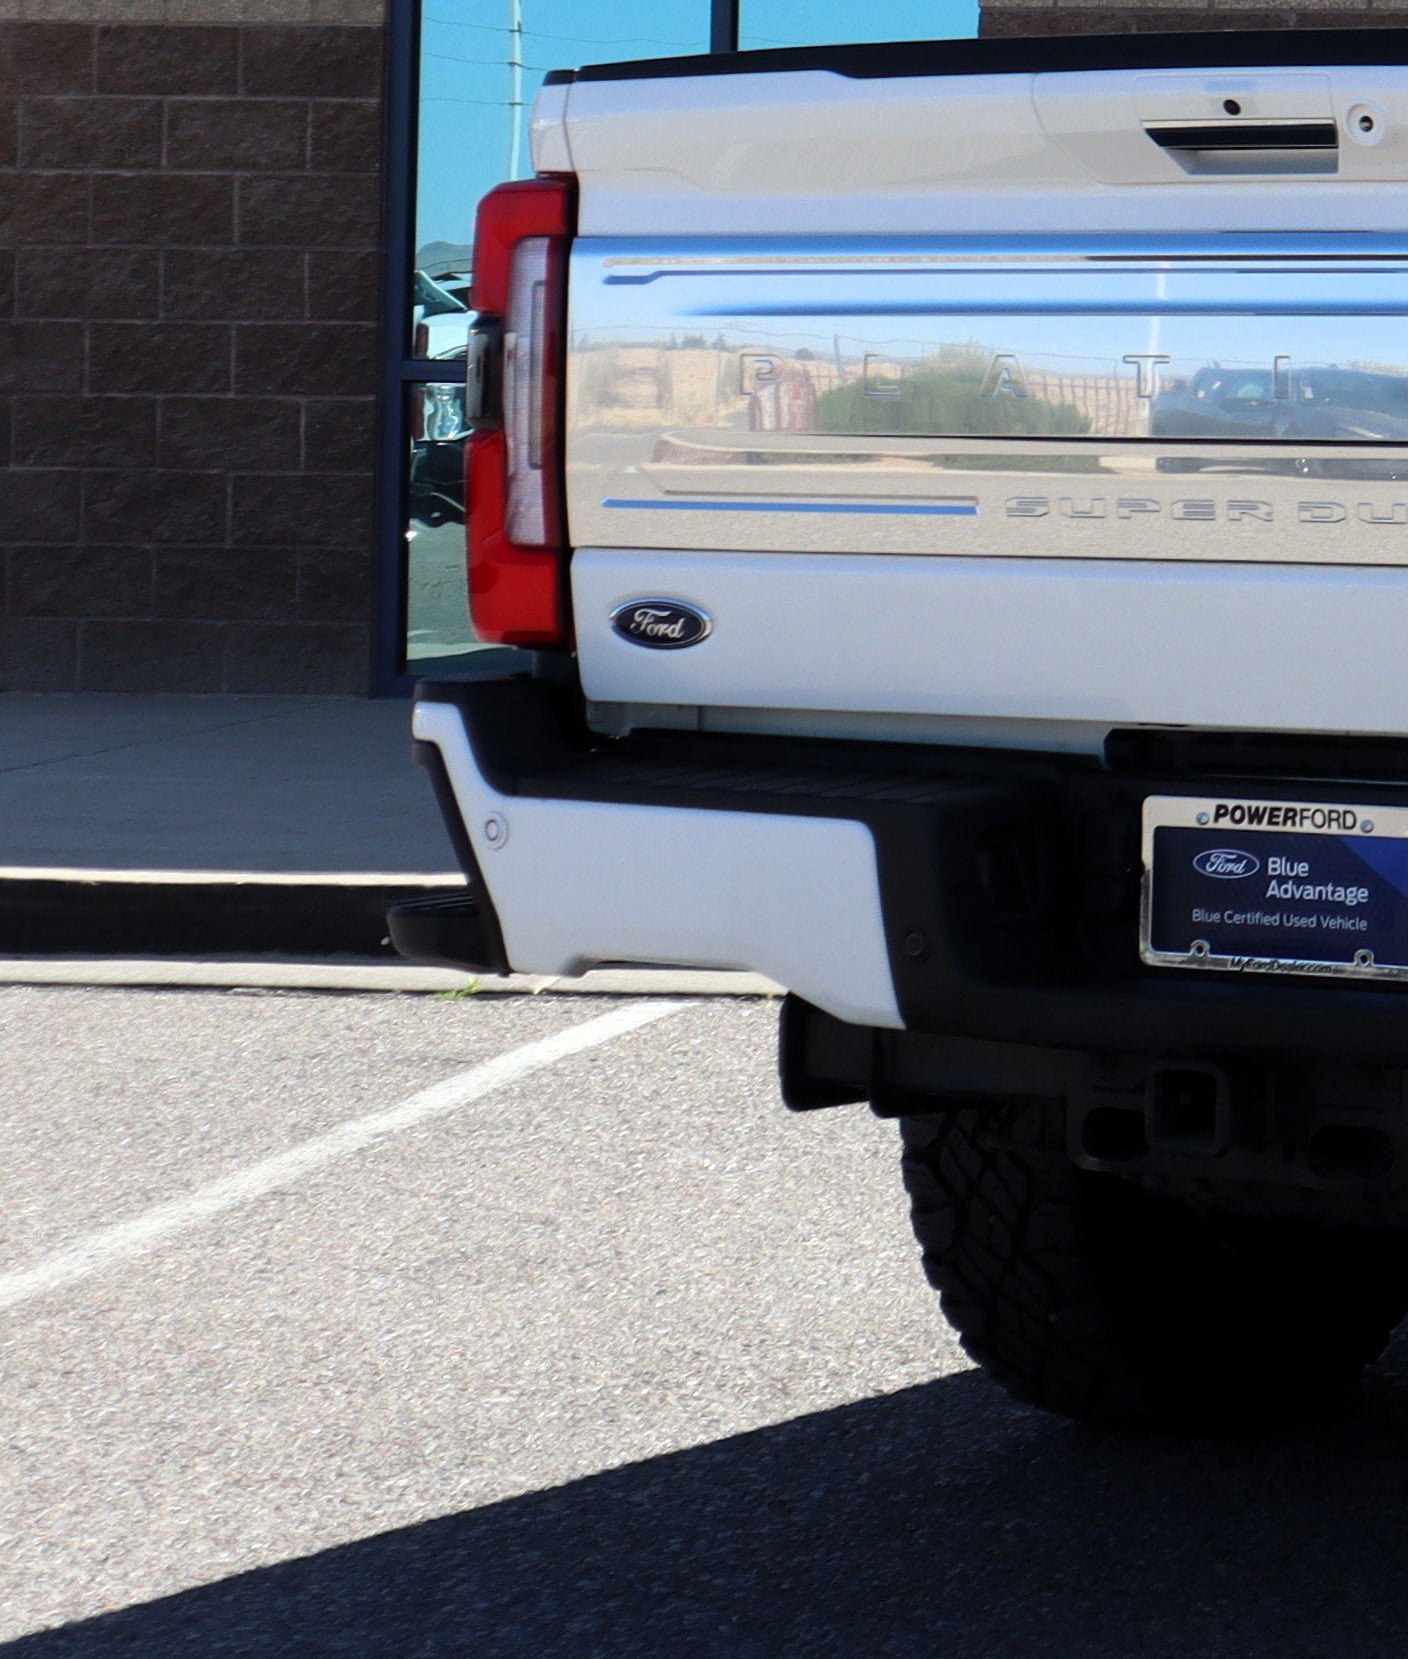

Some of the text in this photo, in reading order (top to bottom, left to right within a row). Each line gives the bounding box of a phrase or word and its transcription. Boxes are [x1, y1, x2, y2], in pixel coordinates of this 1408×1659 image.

[1005, 495, 1275, 523] SUPER
[630, 607, 685, 641] Ford
[1213, 803, 1357, 830] POWERFORD
[1205, 853, 1249, 875] Ford
[1267, 856, 1309, 877] Blue
[1265, 879, 1369, 906] Advantage
[1192, 908, 1368, 931] Blue Certified Used Vehicle
